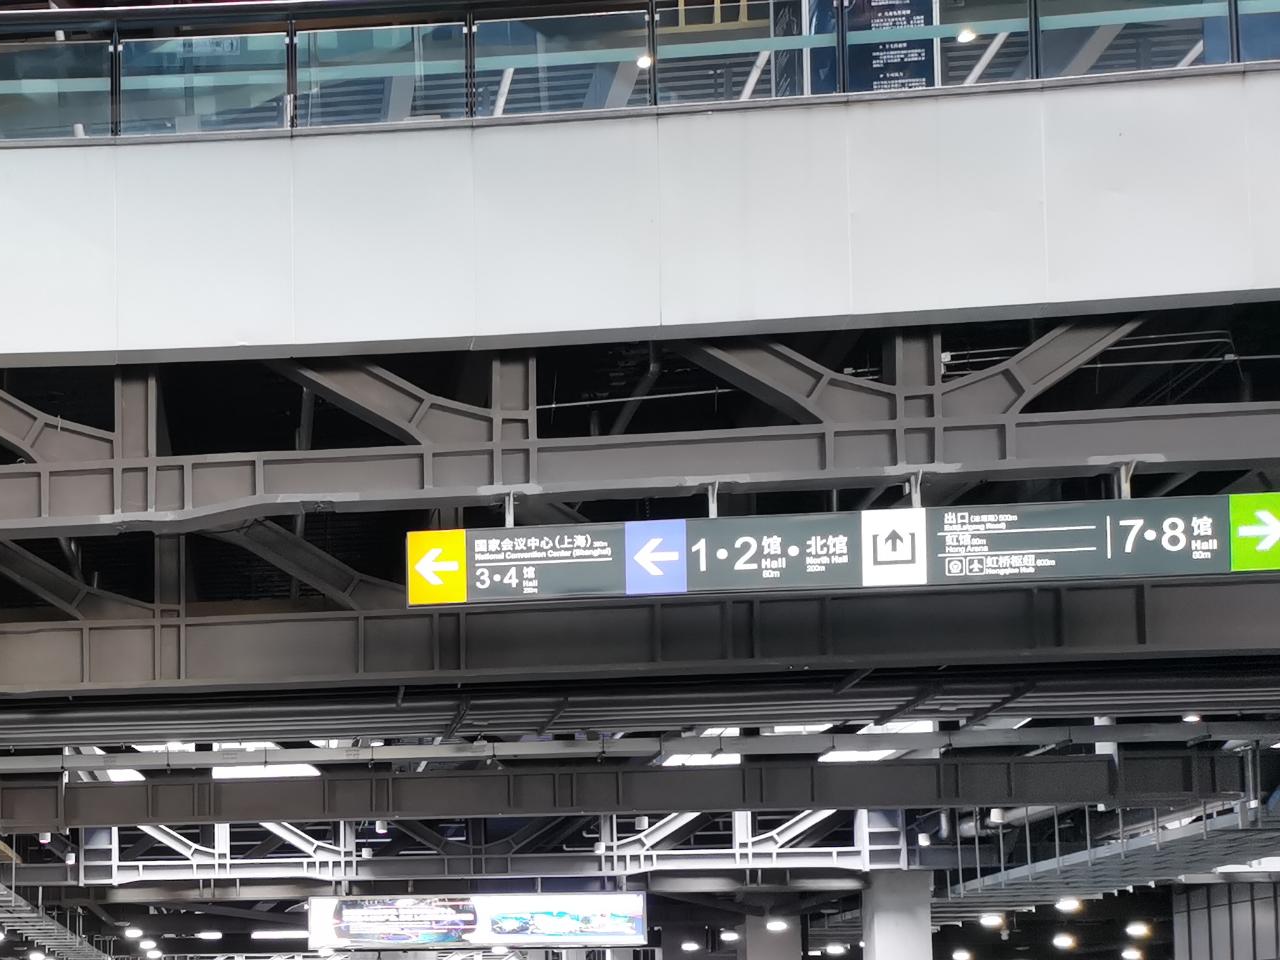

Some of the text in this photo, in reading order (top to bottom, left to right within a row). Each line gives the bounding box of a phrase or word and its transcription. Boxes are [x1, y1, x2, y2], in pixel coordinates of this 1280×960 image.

[945, 545, 989, 556] Hong Arena
[1191, 539, 1218, 551] Hall
[761, 557, 787, 569] Hall
[805, 554, 849, 565] North Hall
